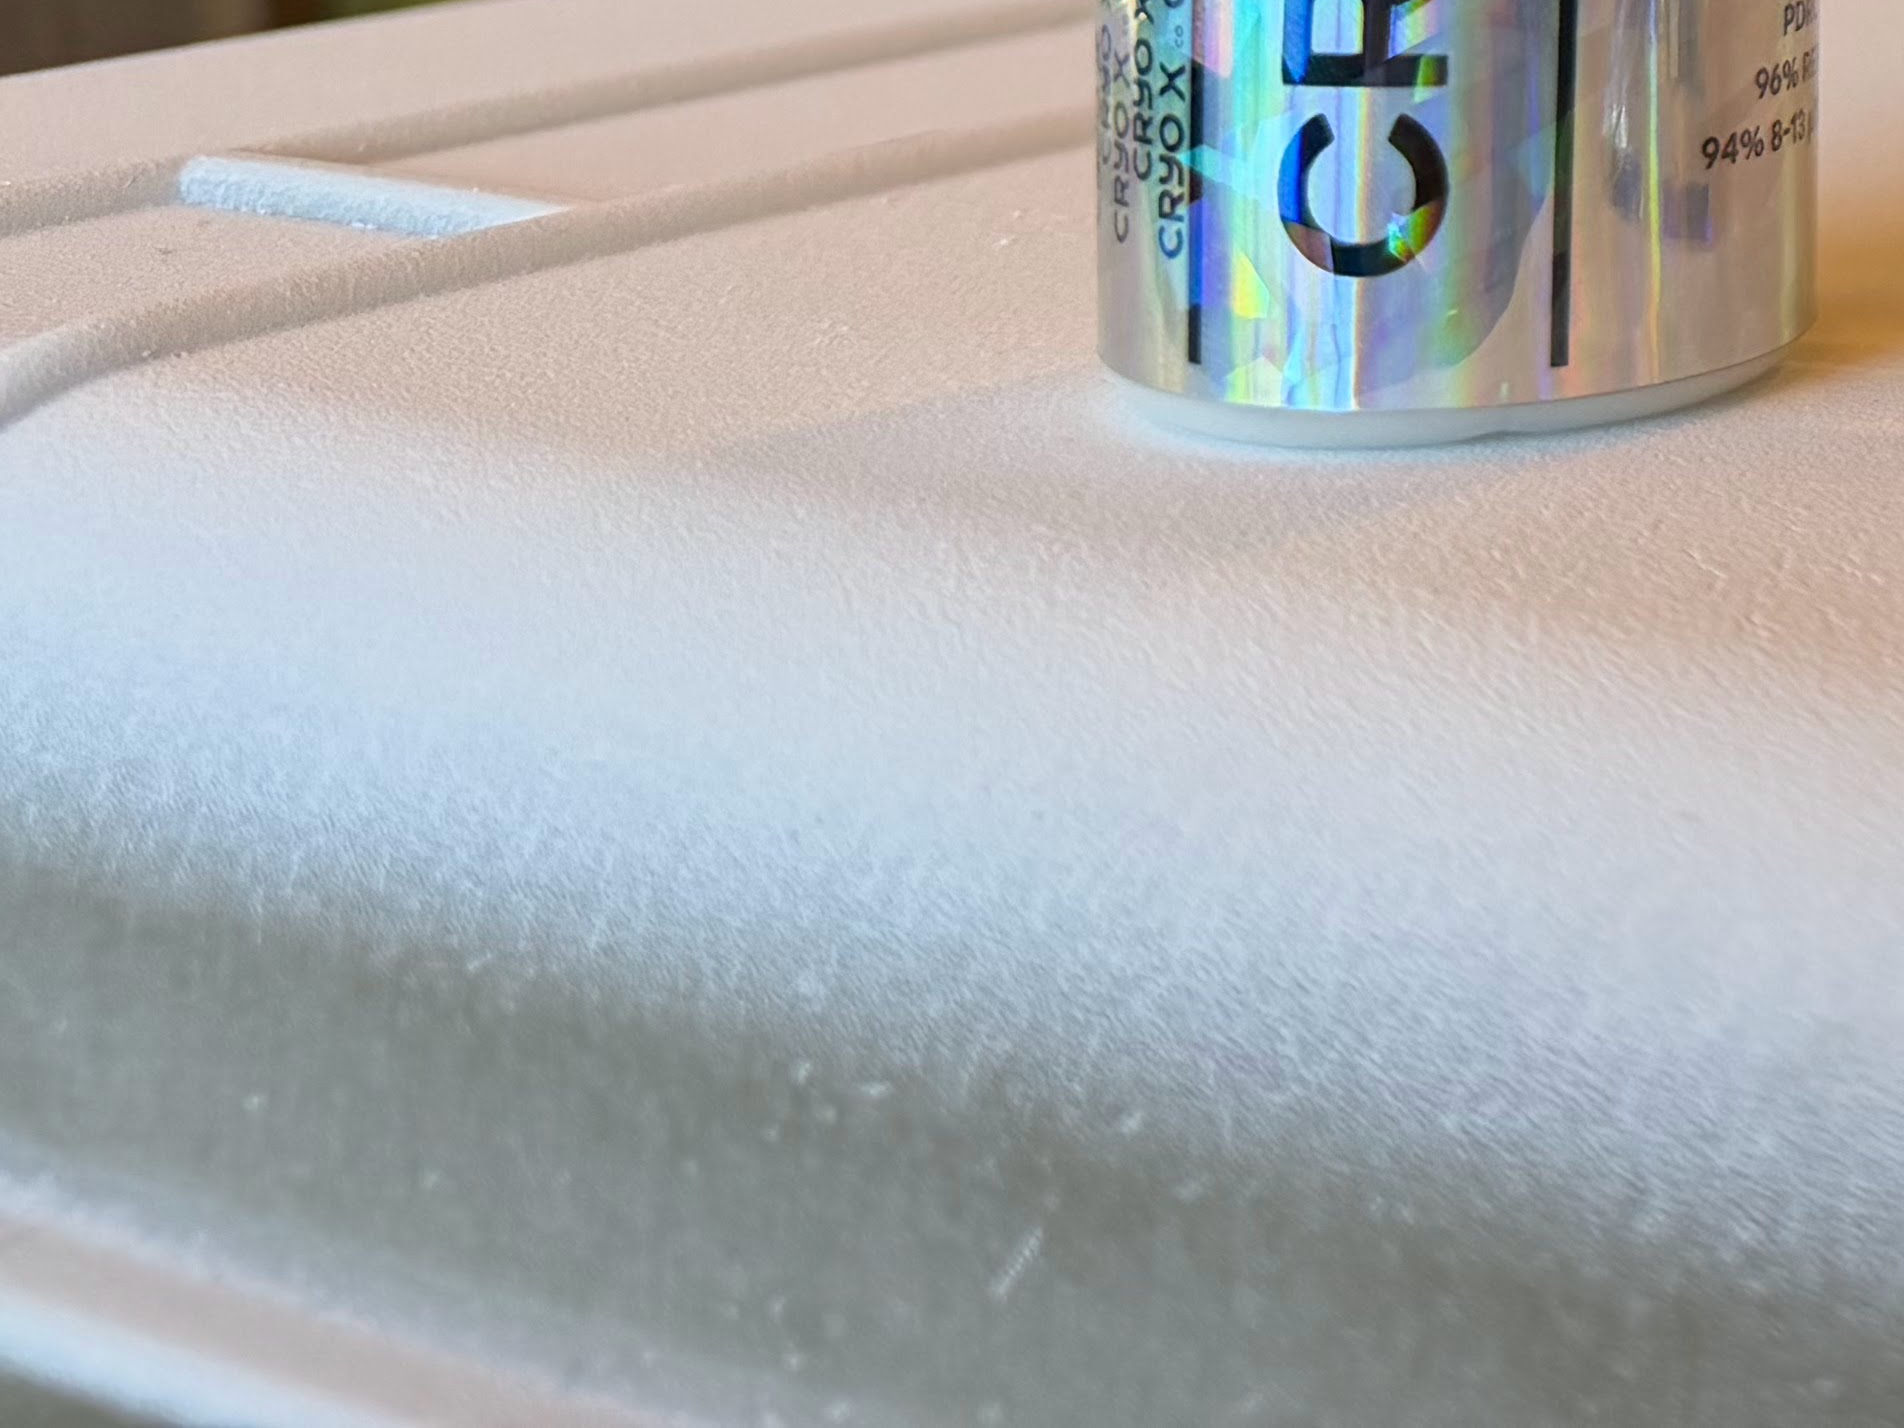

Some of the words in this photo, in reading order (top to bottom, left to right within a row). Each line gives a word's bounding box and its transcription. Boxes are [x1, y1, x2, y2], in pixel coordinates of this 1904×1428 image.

[1114, 50, 1131, 89] X
[1159, 61, 1186, 103] X
[1755, 56, 1799, 99] 96%
[1133, 38, 1154, 182] CRYO
[1701, 125, 1764, 170] 94%
[1113, 101, 1130, 244] CRYO
[1158, 113, 1186, 260] CRYO
